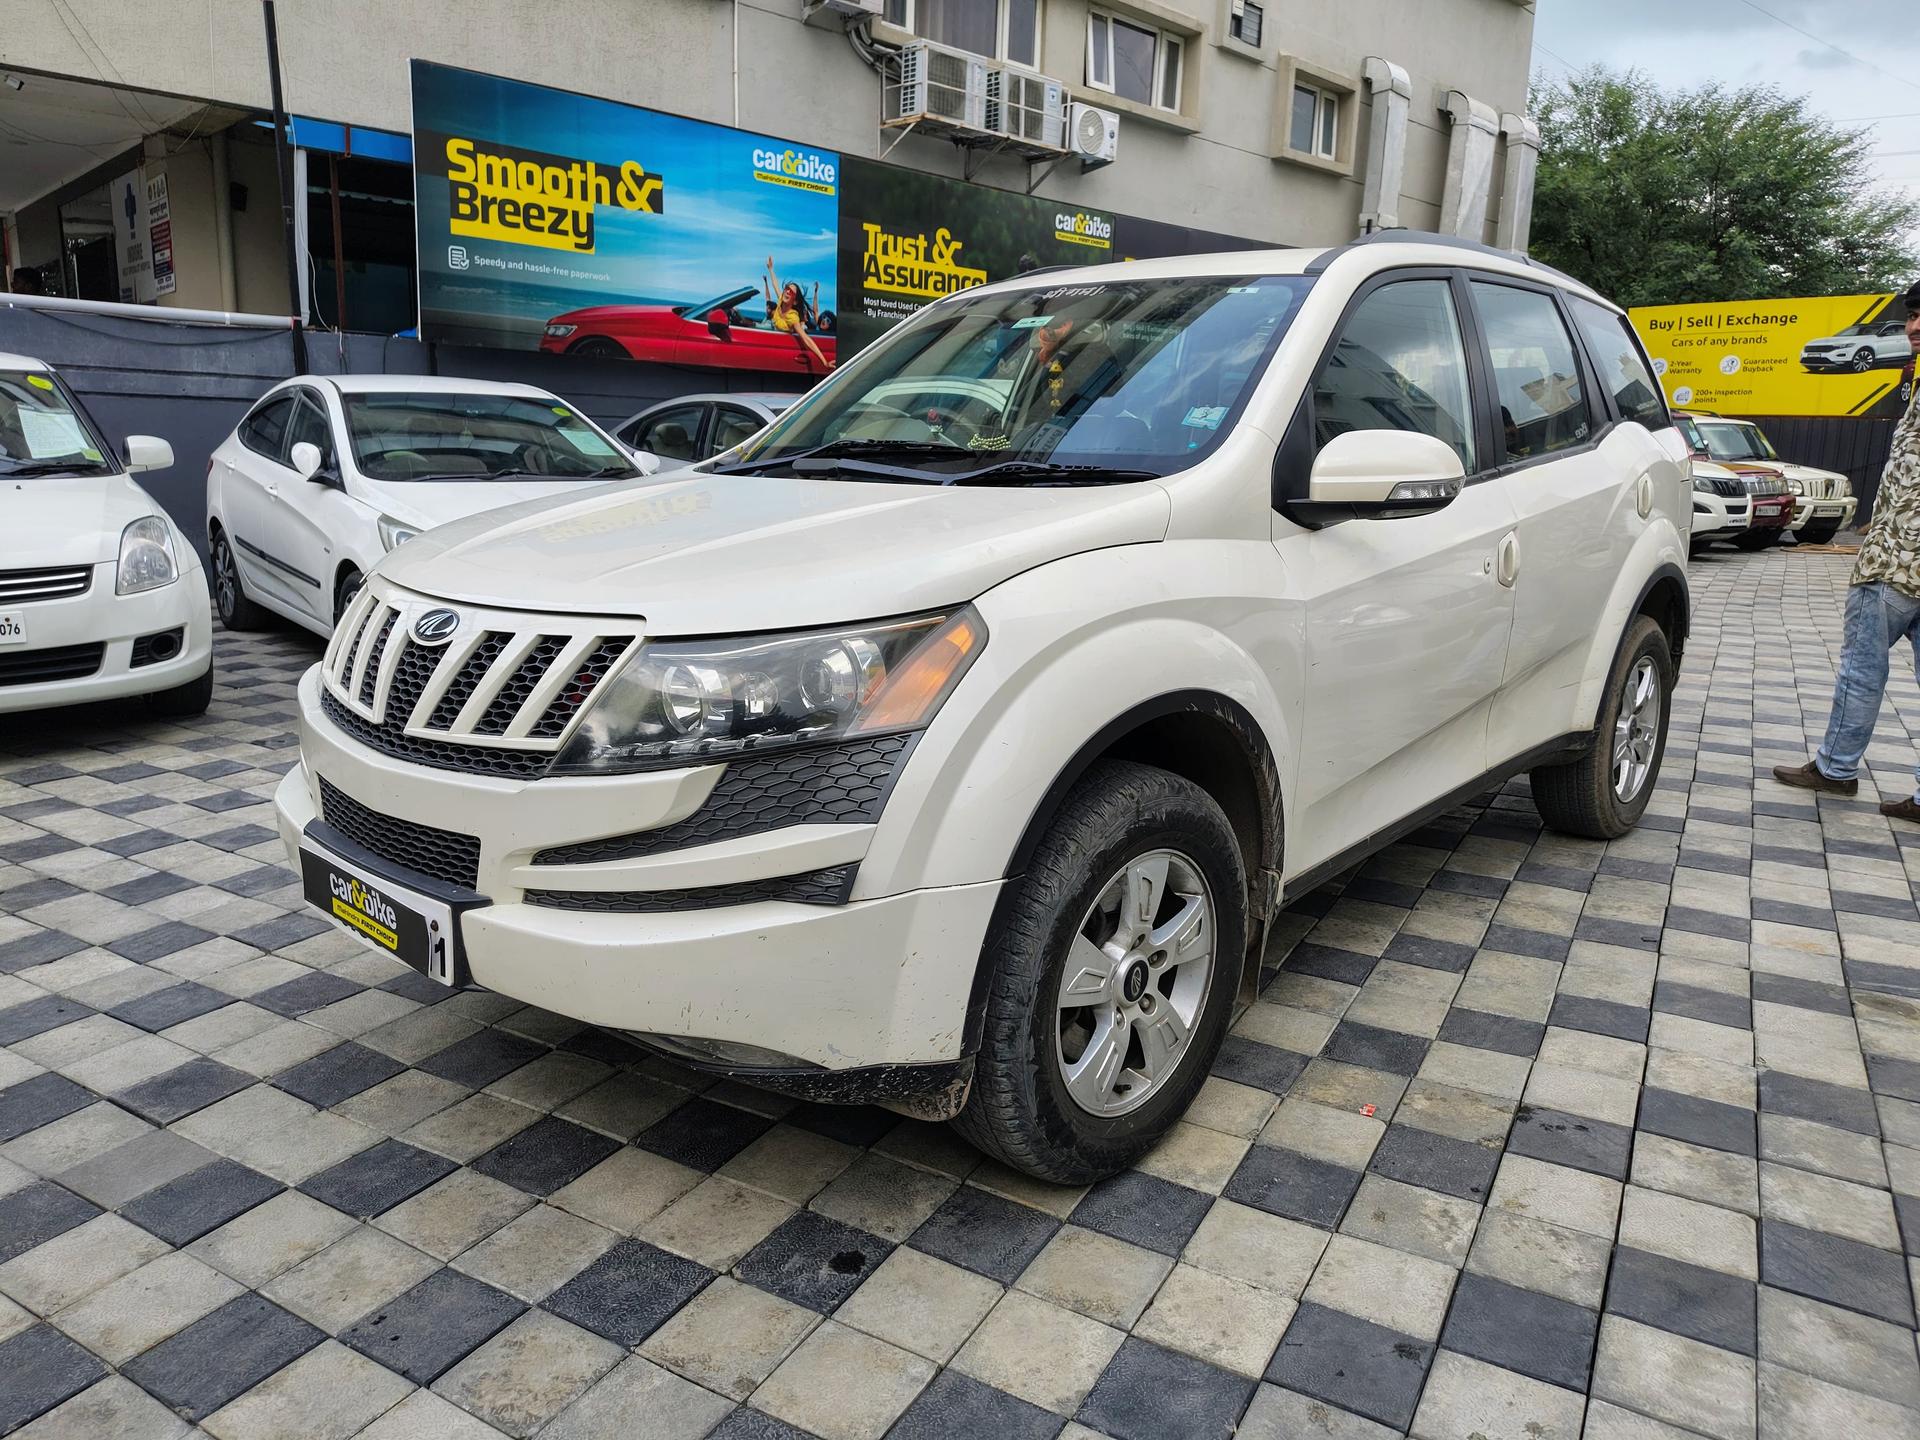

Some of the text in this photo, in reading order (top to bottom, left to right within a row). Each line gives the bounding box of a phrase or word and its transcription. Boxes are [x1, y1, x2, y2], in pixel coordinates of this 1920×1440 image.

[752, 148, 836, 183] car&bike
[446, 138, 664, 213] Smooth &
[788, 179, 806, 189] FIRST
[806, 183, 829, 193] CHOICE
[451, 180, 595, 250] Breezy
[1055, 213, 1111, 239] car&bike
[863, 222, 963, 268] Trust &
[474, 255, 611, 282] Speedy and hassle-free paperwork
[863, 297, 880, 306] Most
[880, 299, 897, 308] loved
[898, 302, 914, 311] Used
[867, 307, 877, 318] By
[877, 309, 907, 320] Franchise
[1649, 319, 1675, 332] Buy
[1687, 315, 1713, 328] Sell
[1726, 313, 1798, 326] Exchange
[1671, 335, 1768, 347] Cars of any brands
[1669, 367, 1702, 375] Warranty
[1742, 365, 1774, 373] Buyback
[1694, 396, 1717, 404] points
[1714, 388, 1753, 397] inspection
[329, 872, 397, 930] car&bike
[361, 918, 376, 933] FIRST
[375, 927, 395, 945] CHOICE
